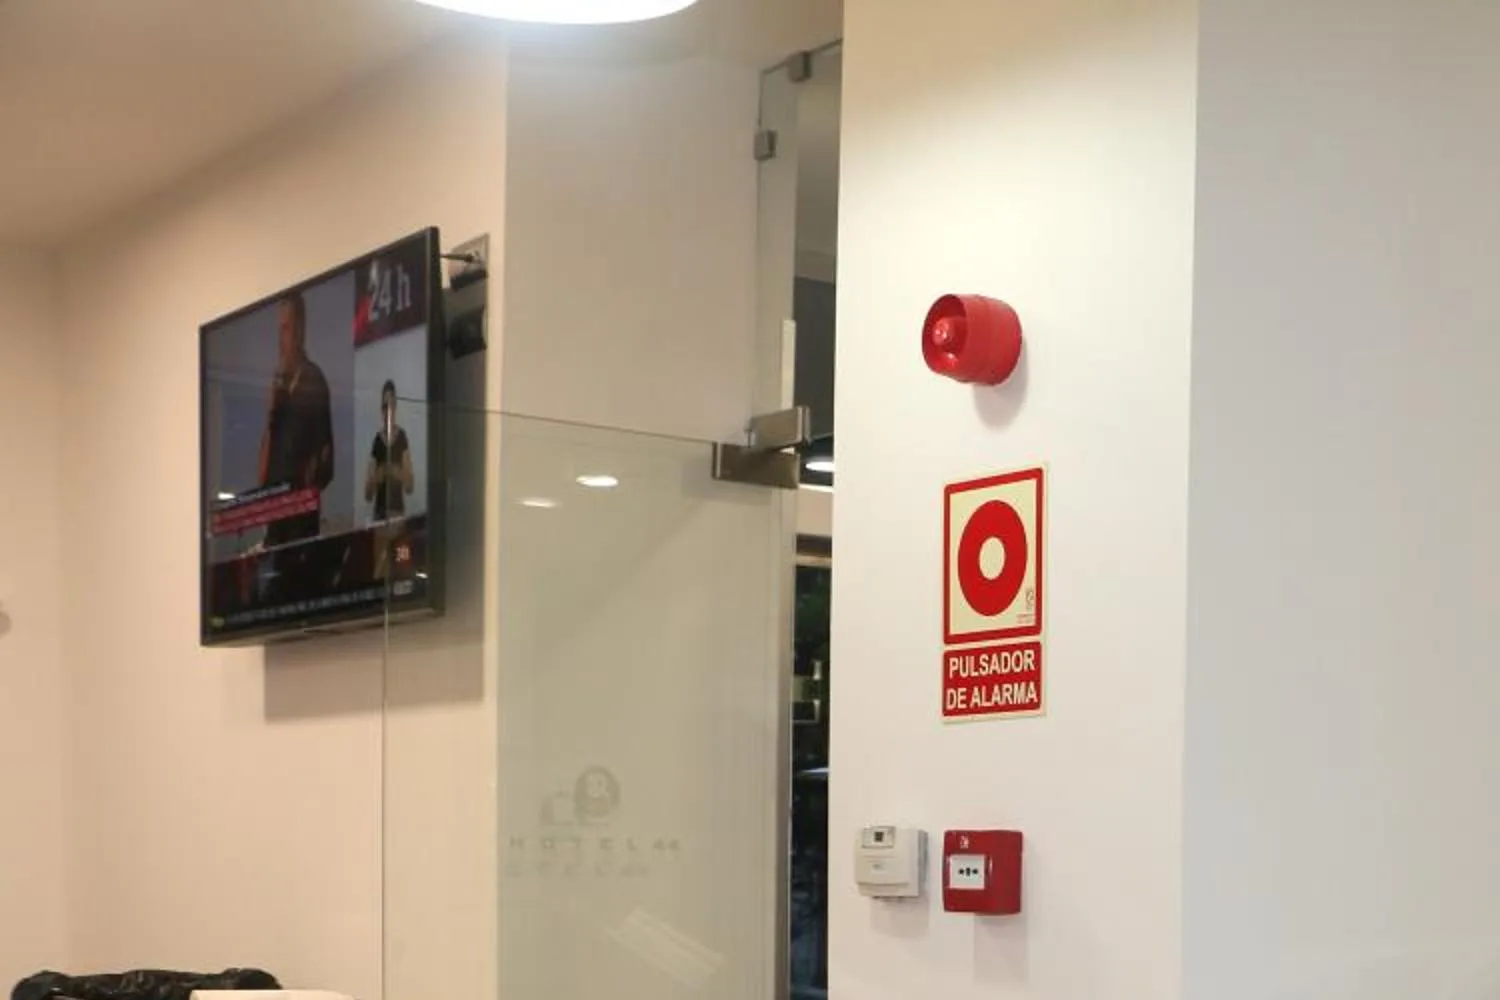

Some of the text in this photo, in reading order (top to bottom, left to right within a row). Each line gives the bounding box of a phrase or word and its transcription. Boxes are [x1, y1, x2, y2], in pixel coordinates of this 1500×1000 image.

[948, 649, 1036, 679] PULSADOR
[946, 681, 1038, 710] DE ALARMA
